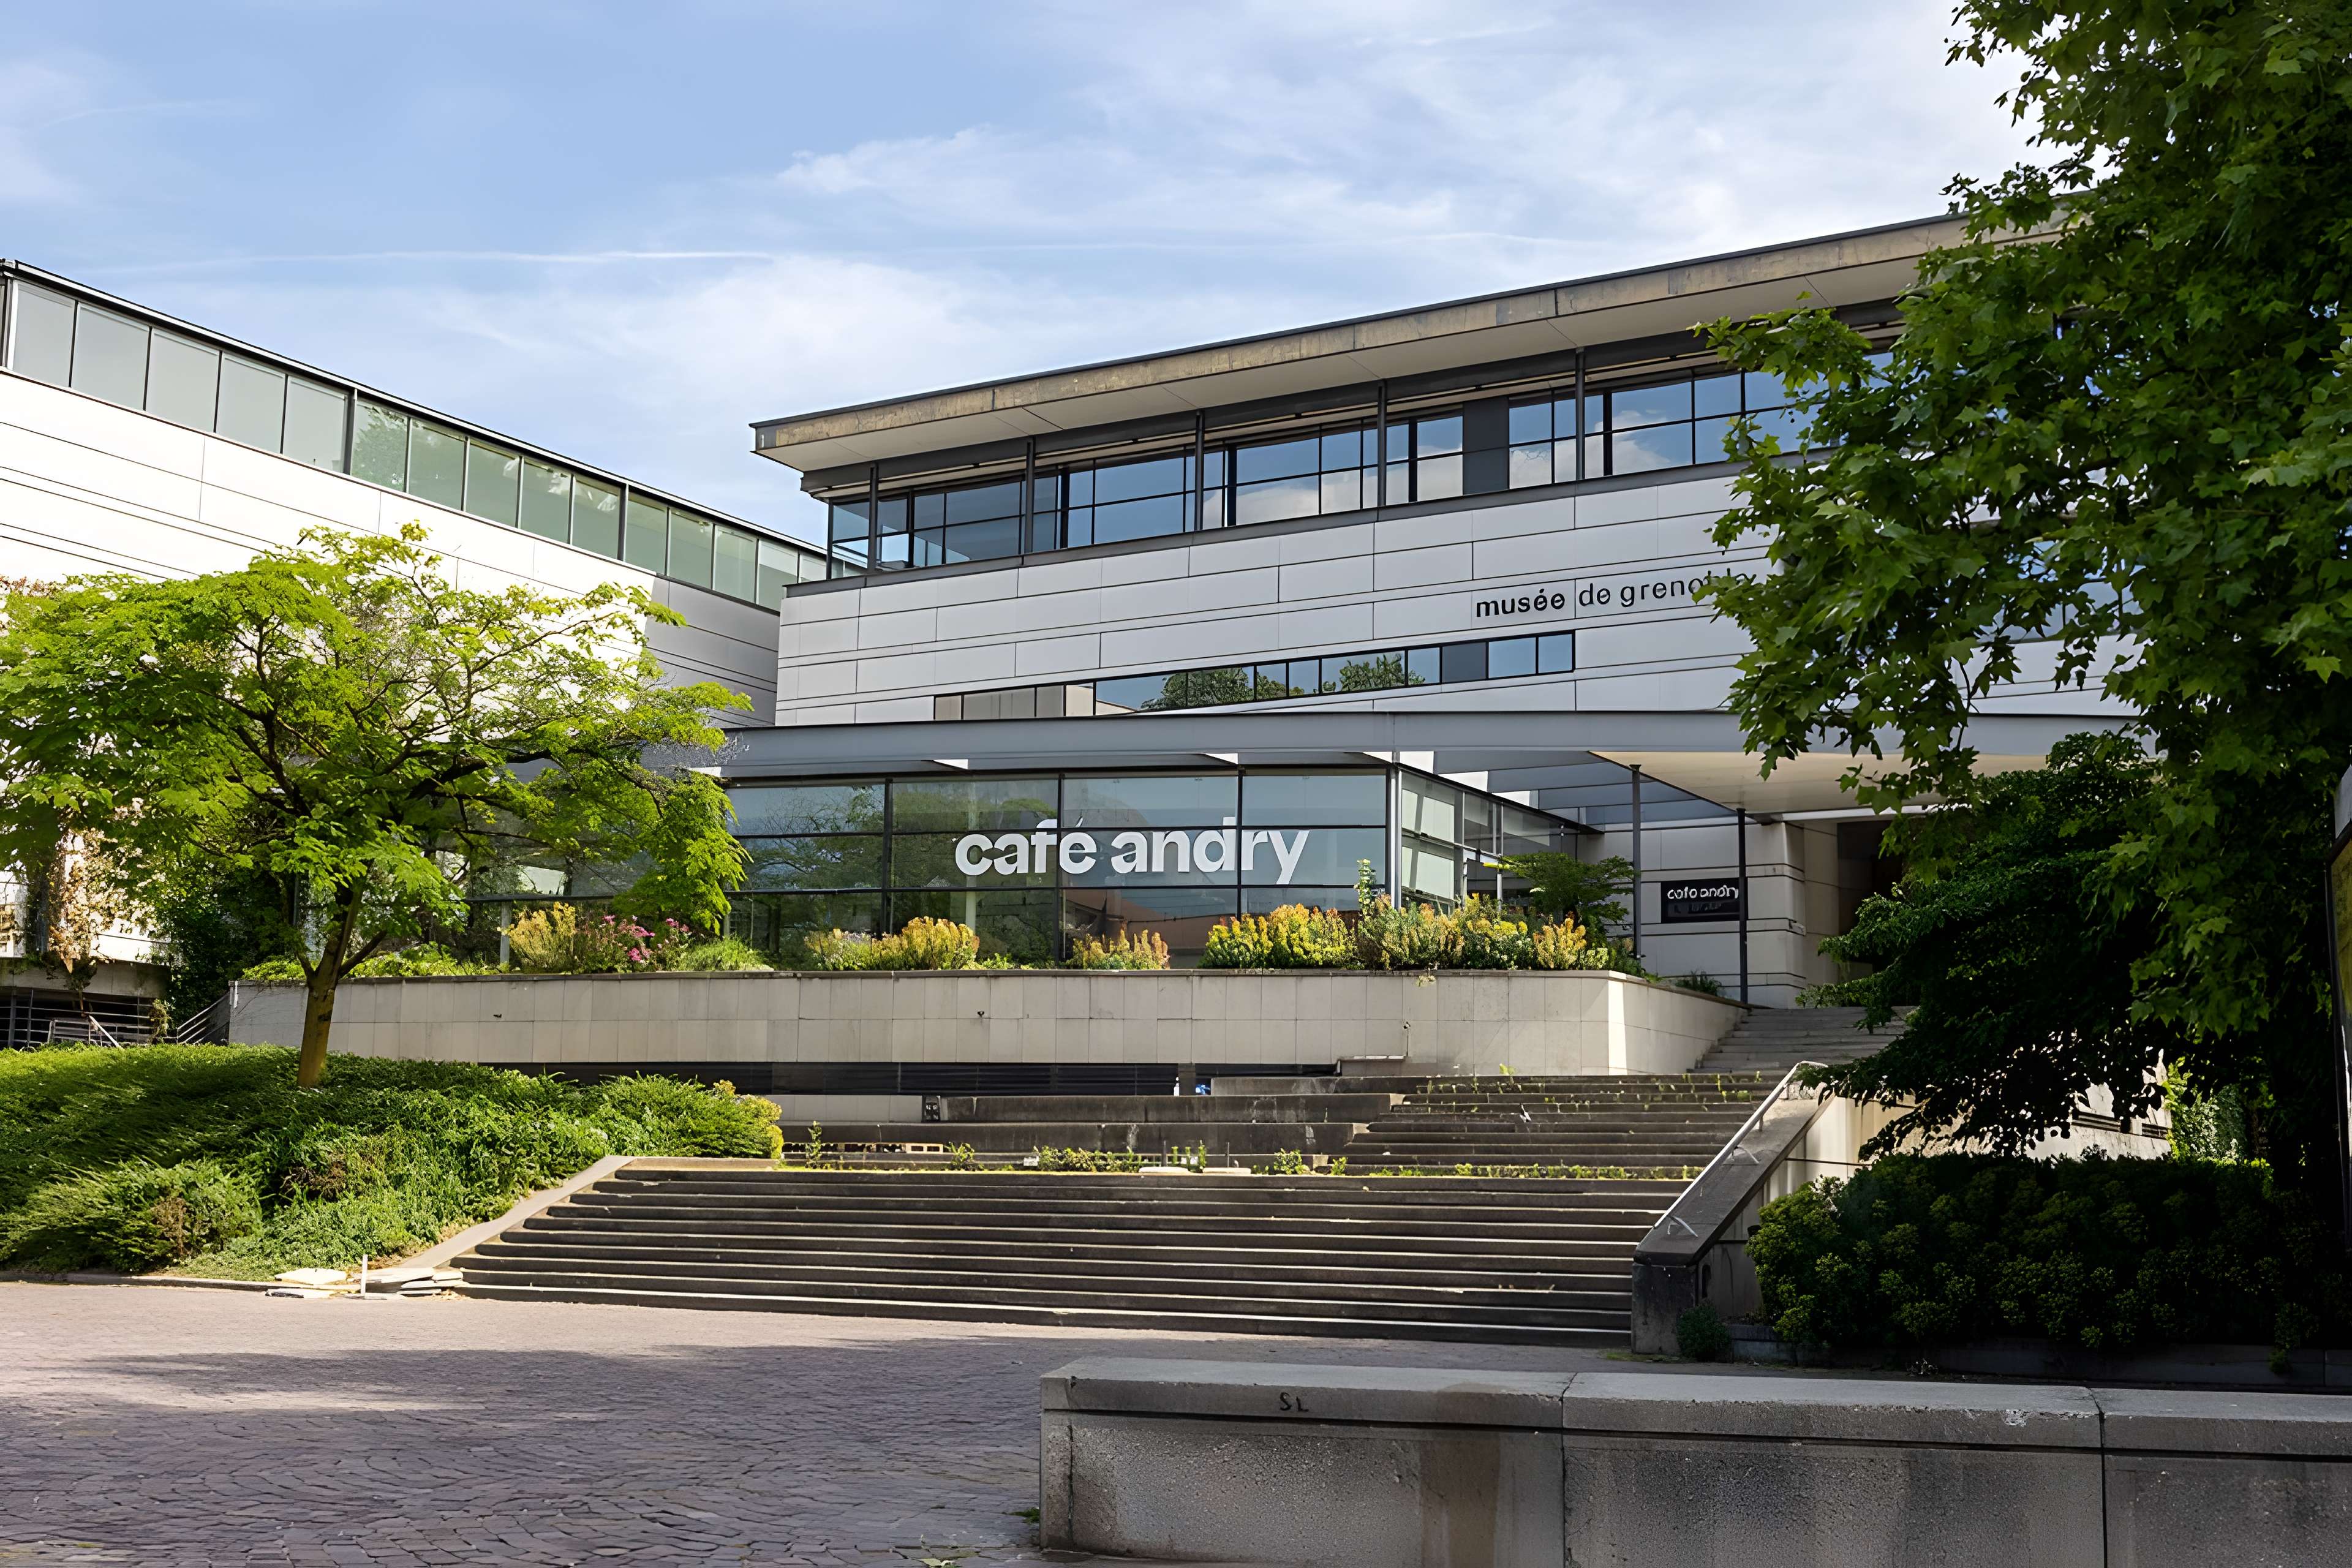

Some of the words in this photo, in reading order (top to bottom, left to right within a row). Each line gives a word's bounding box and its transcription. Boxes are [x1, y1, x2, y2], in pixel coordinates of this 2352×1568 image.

[1476, 588, 1566, 617] musée
[1578, 583, 1611, 607] de
[1619, 567, 1758, 608] greno
[955, 816, 1096, 876] café
[1111, 816, 1310, 885] andry
